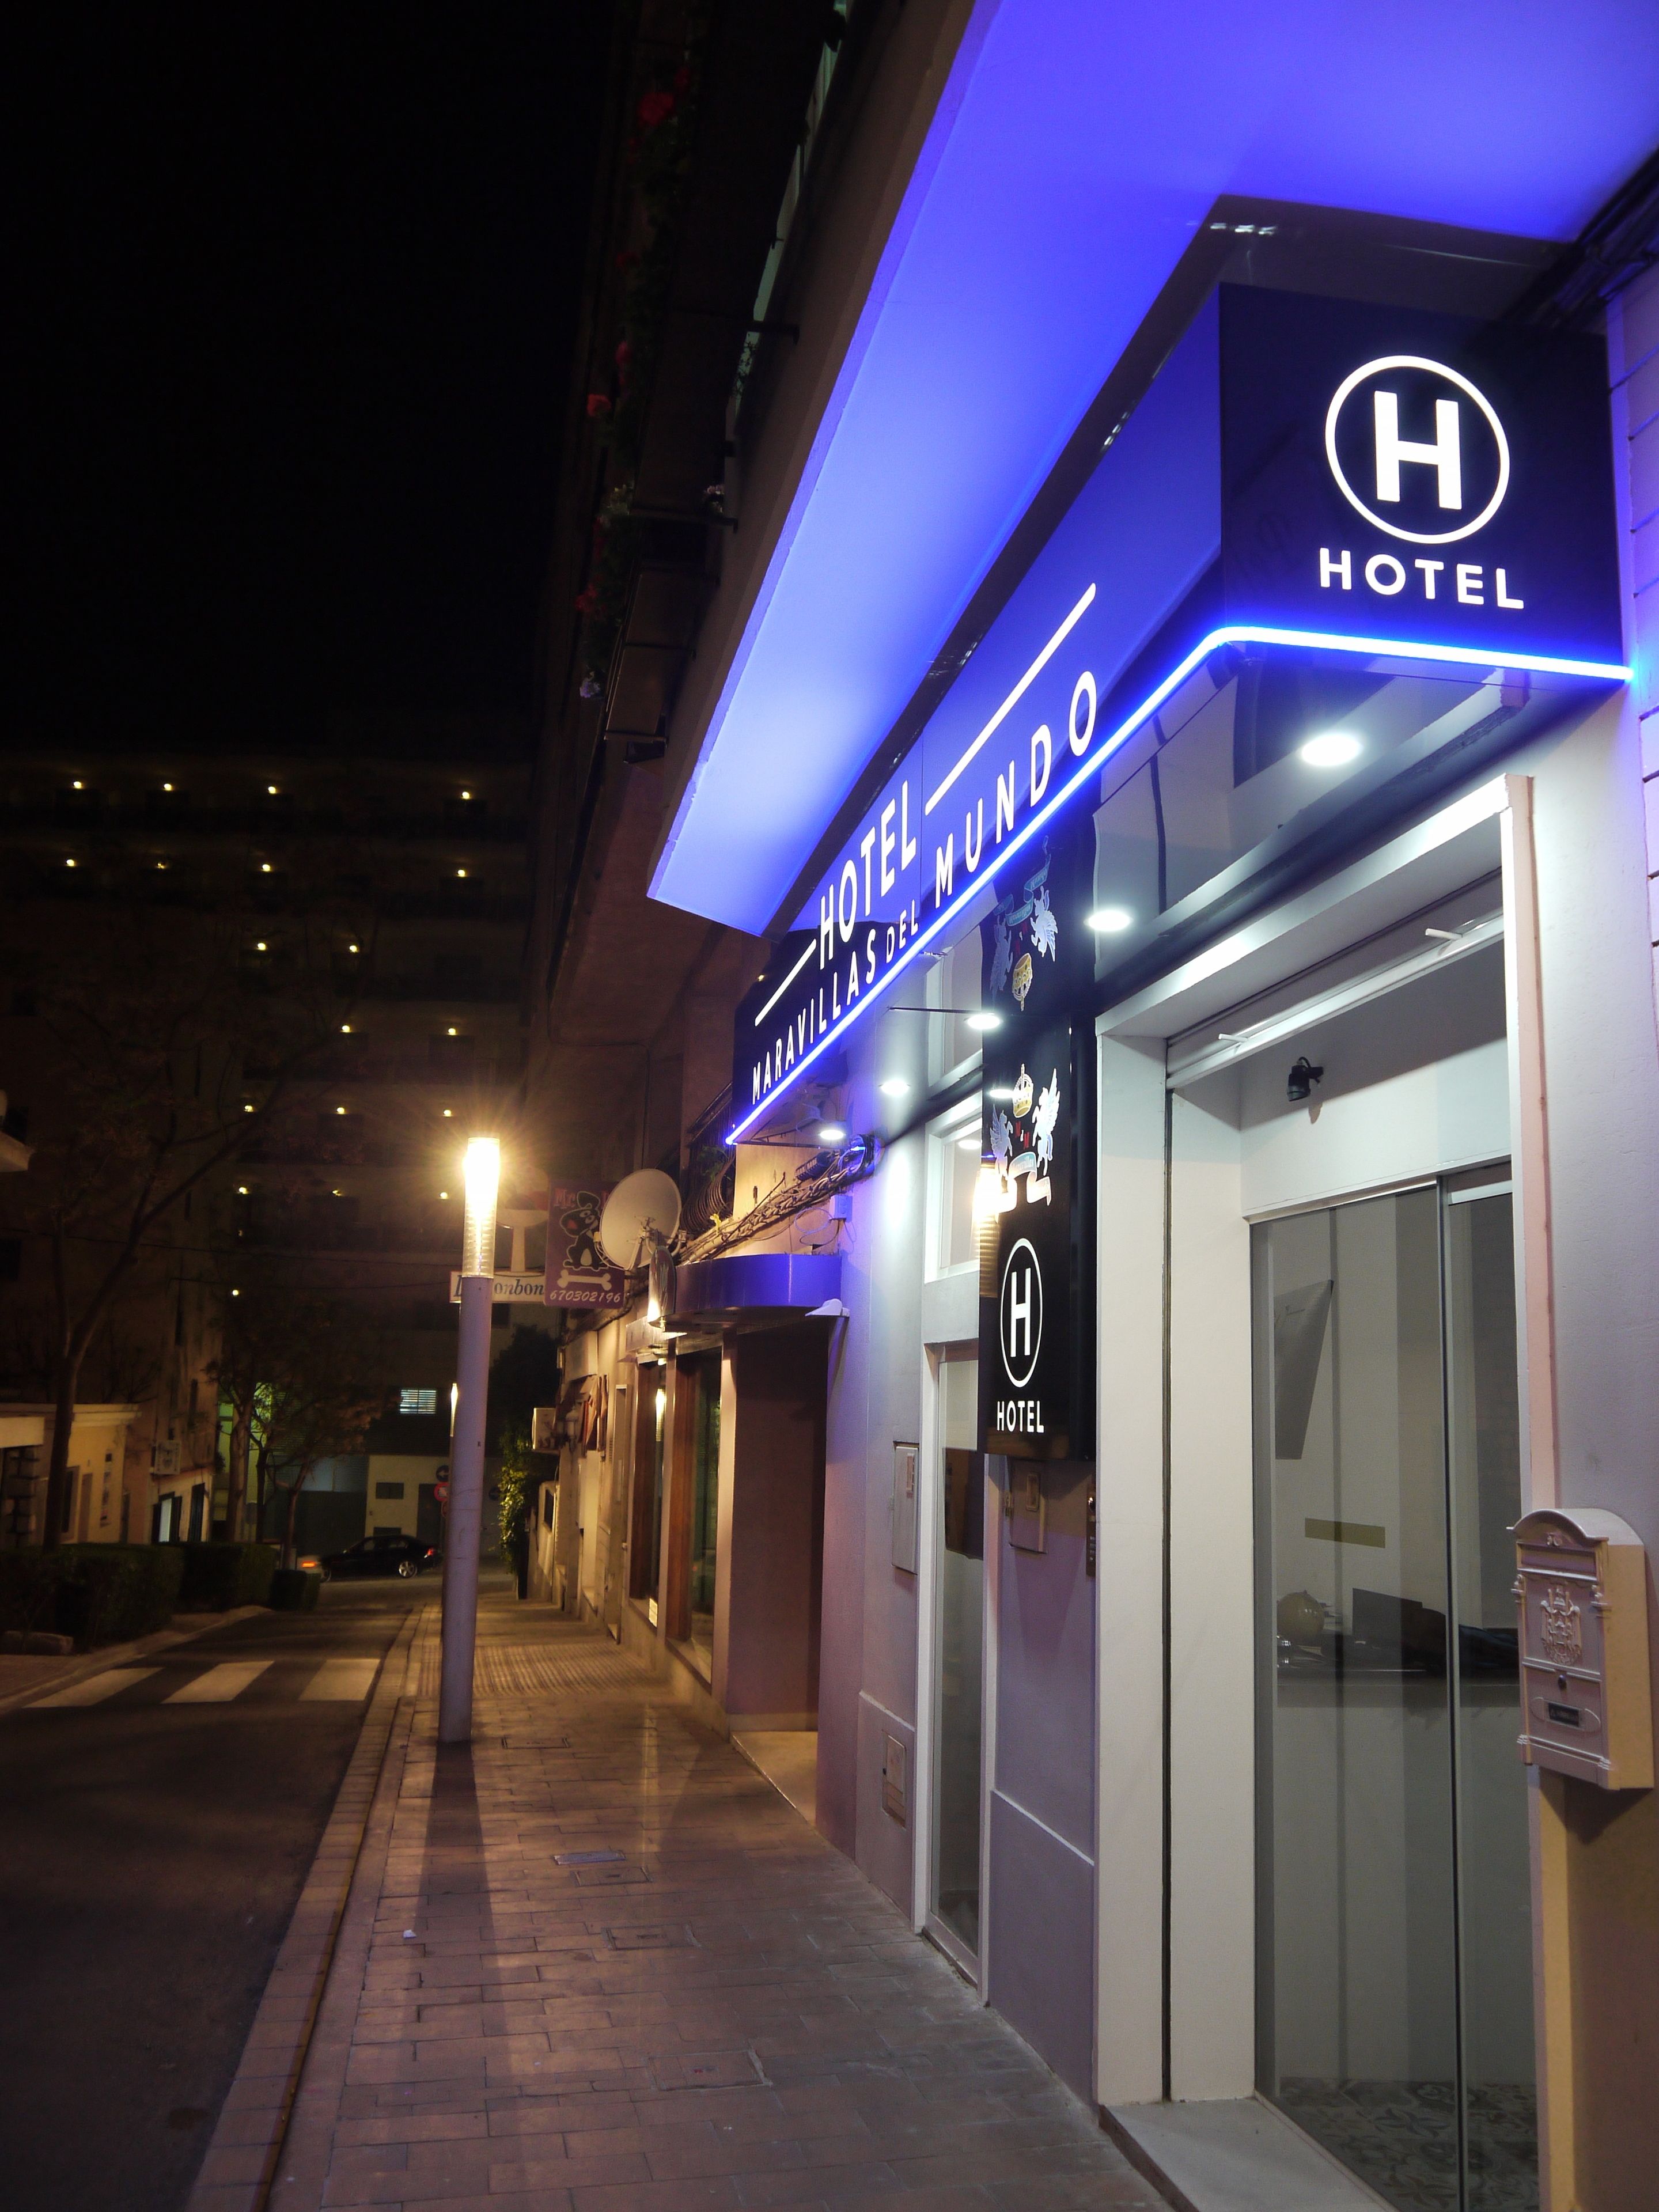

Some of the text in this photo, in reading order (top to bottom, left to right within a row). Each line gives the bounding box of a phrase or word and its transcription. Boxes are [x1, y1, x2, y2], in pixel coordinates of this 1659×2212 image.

[1373, 390, 1463, 510] H
[1319, 547, 1524, 609] HOTEL
[752, 671, 1097, 1105] MARAVILLAS DEL MUNDO
[819, 779, 917, 970] HOTEL
[493, 1278, 544, 1296] onbon
[550, 1290, 621, 1303] 670302196
[1010, 1267, 1032, 1358] H
[997, 1400, 1044, 1433] HOTEL
